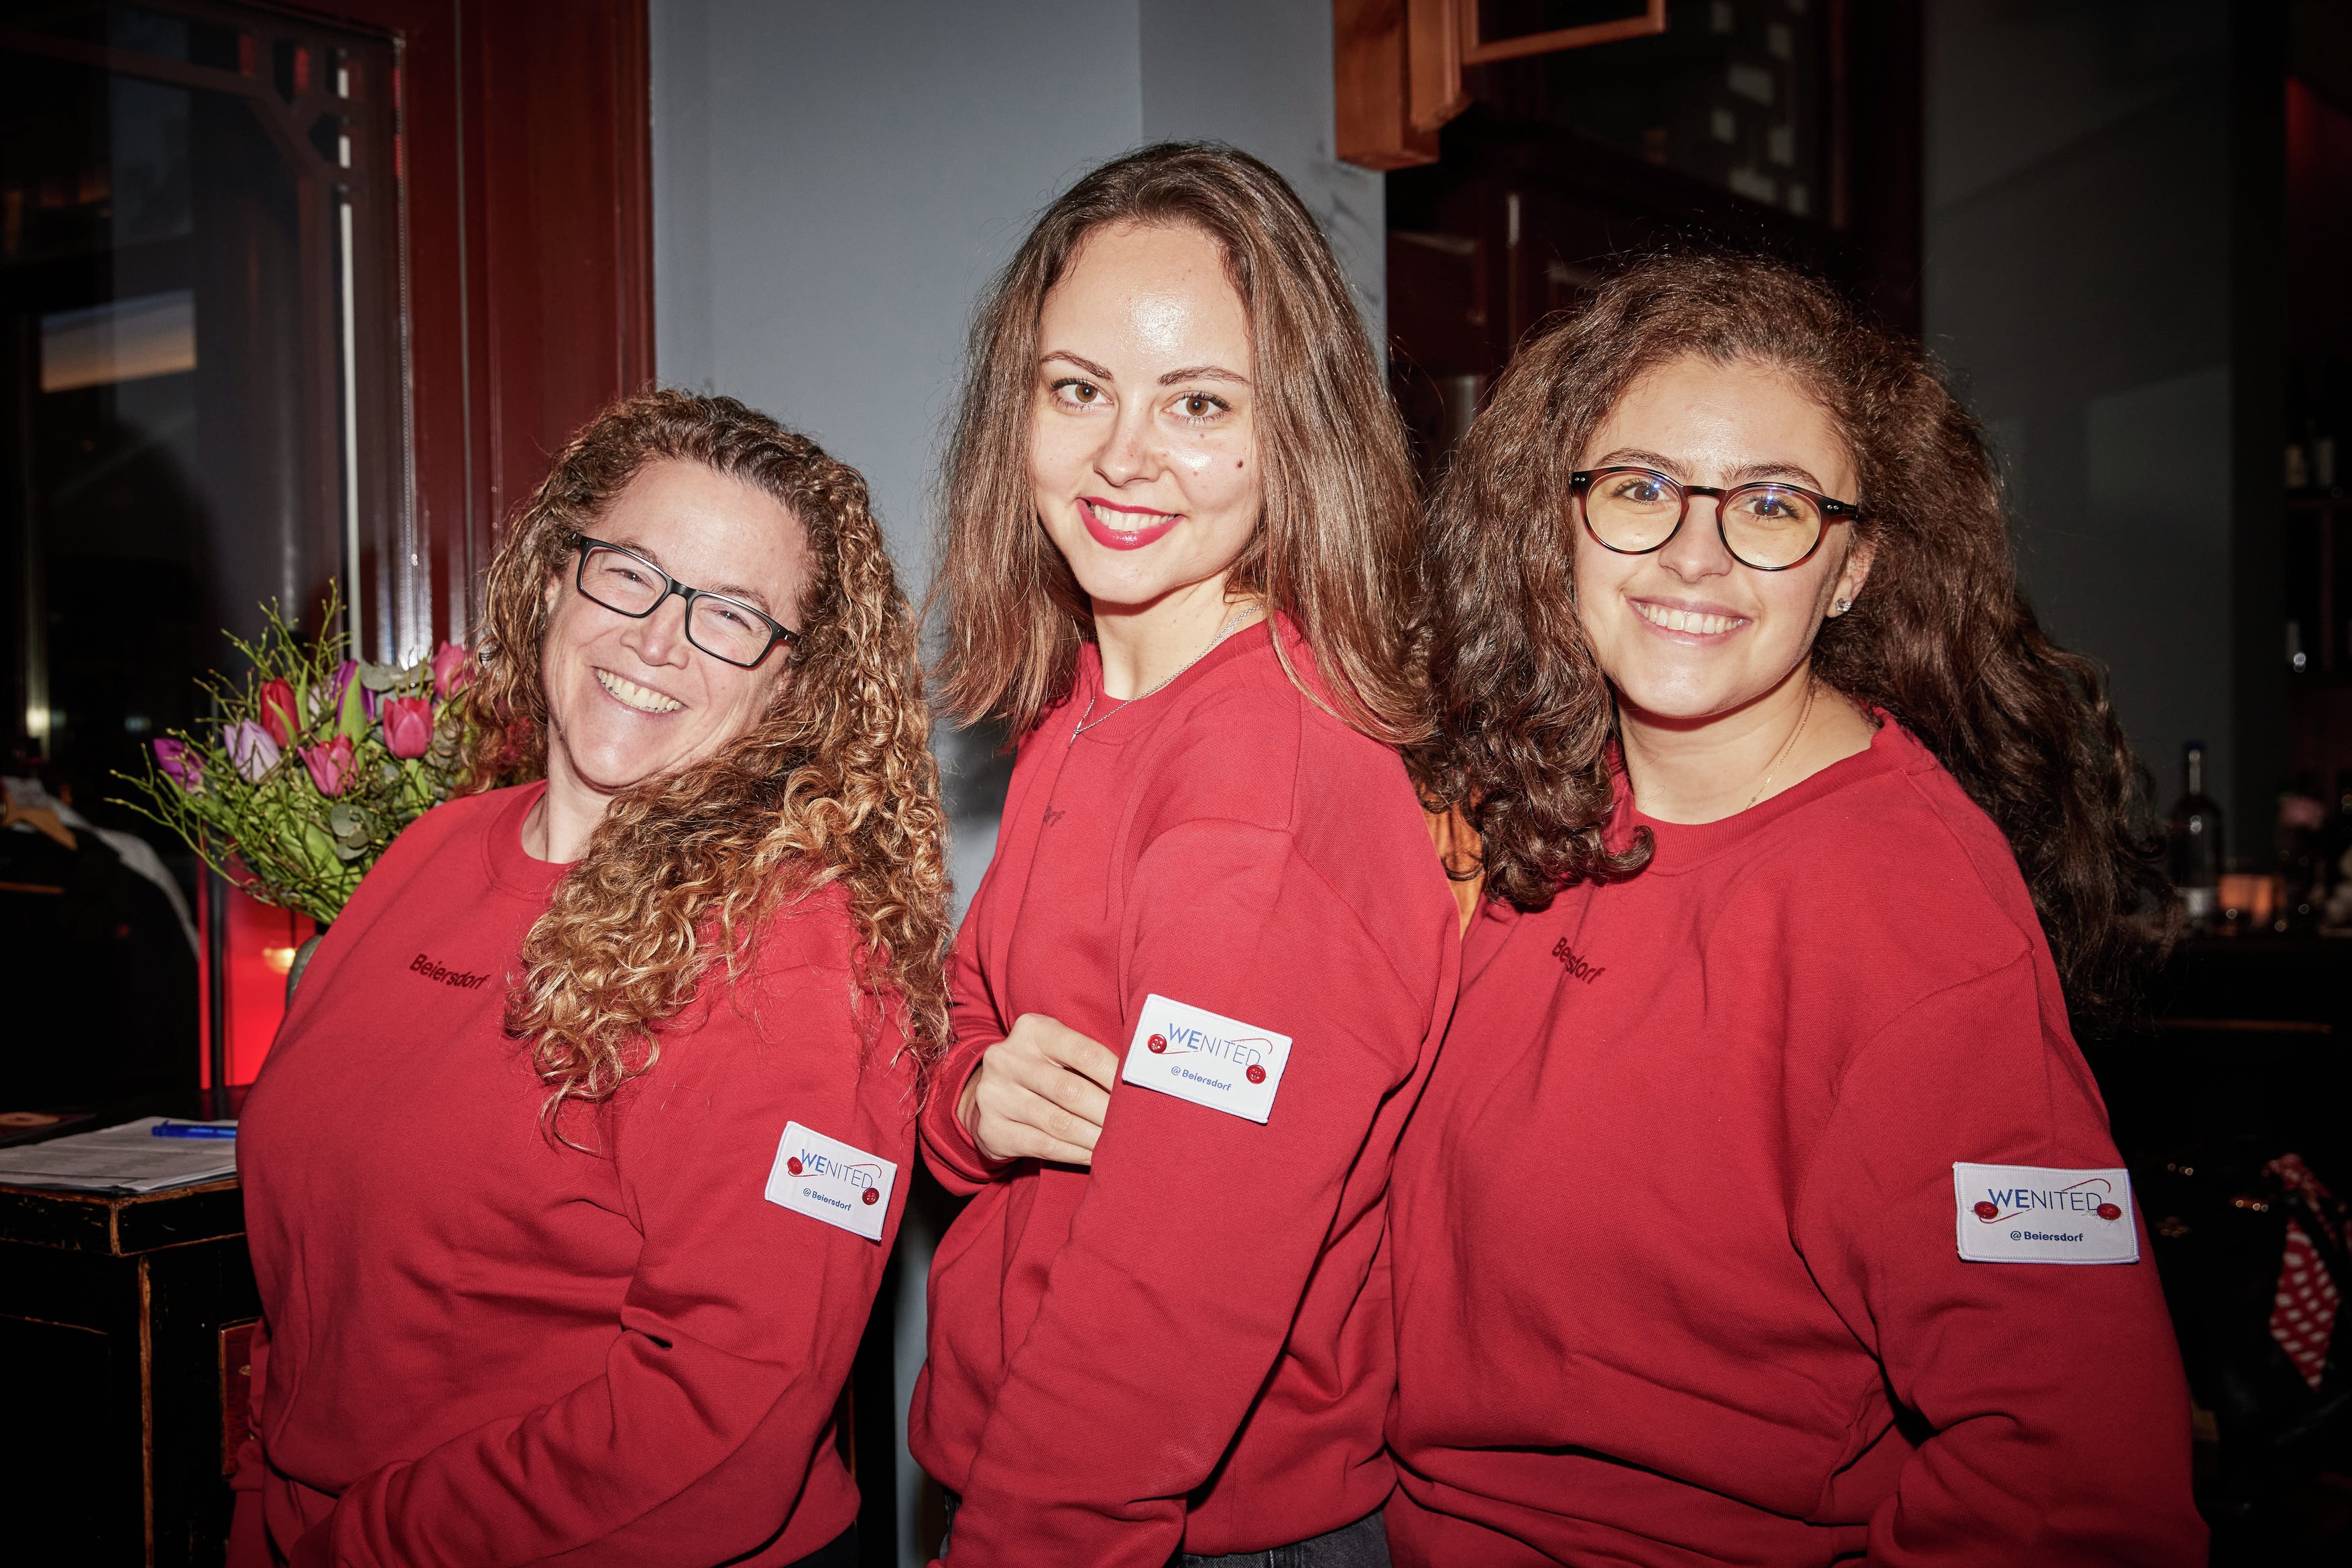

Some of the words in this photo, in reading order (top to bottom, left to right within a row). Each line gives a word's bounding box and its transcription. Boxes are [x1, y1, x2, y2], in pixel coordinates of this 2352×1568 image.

[410, 953, 491, 989] Beiersdorf
[1169, 1023, 1261, 1067] WENITED
[801, 1148, 873, 1189] WENITED
[1988, 1189, 2103, 1211] WENITED
